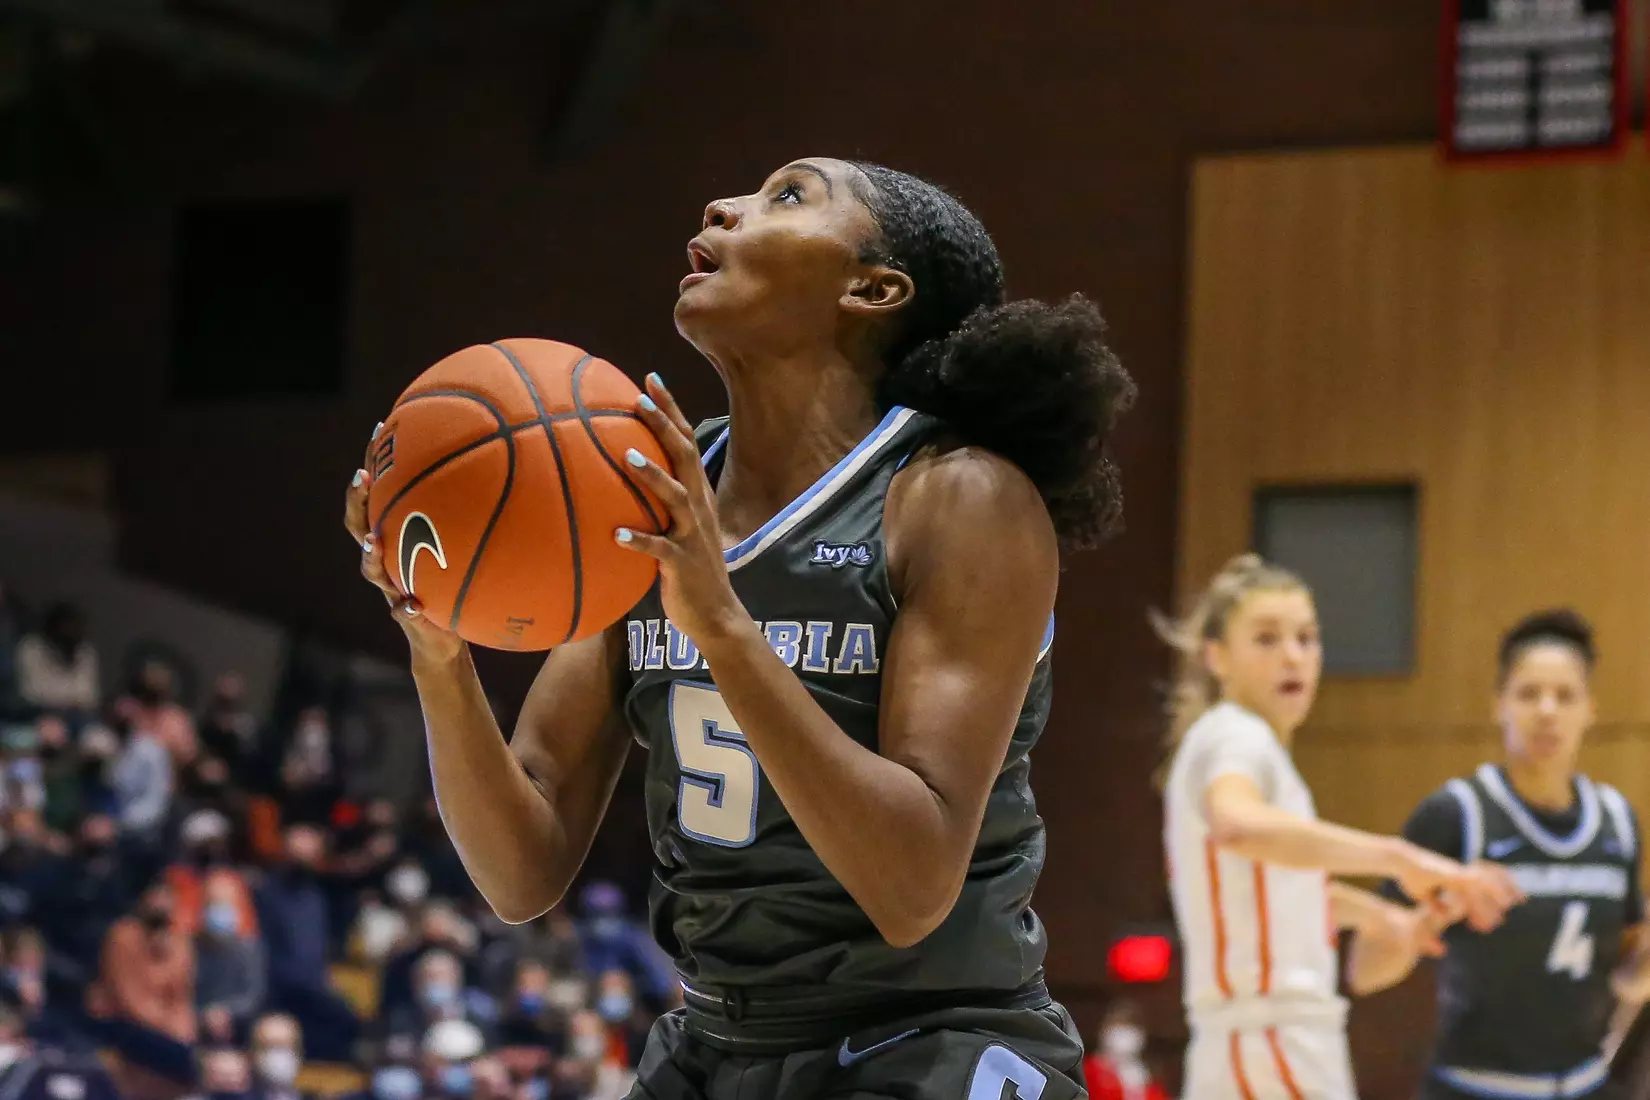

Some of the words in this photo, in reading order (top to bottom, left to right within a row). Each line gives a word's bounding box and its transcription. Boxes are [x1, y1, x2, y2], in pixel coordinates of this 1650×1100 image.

[812, 542, 851, 566] Ivy
[627, 618, 880, 674] OLUBIA
[668, 679, 760, 849] 5
[1546, 901, 1595, 982] 4
